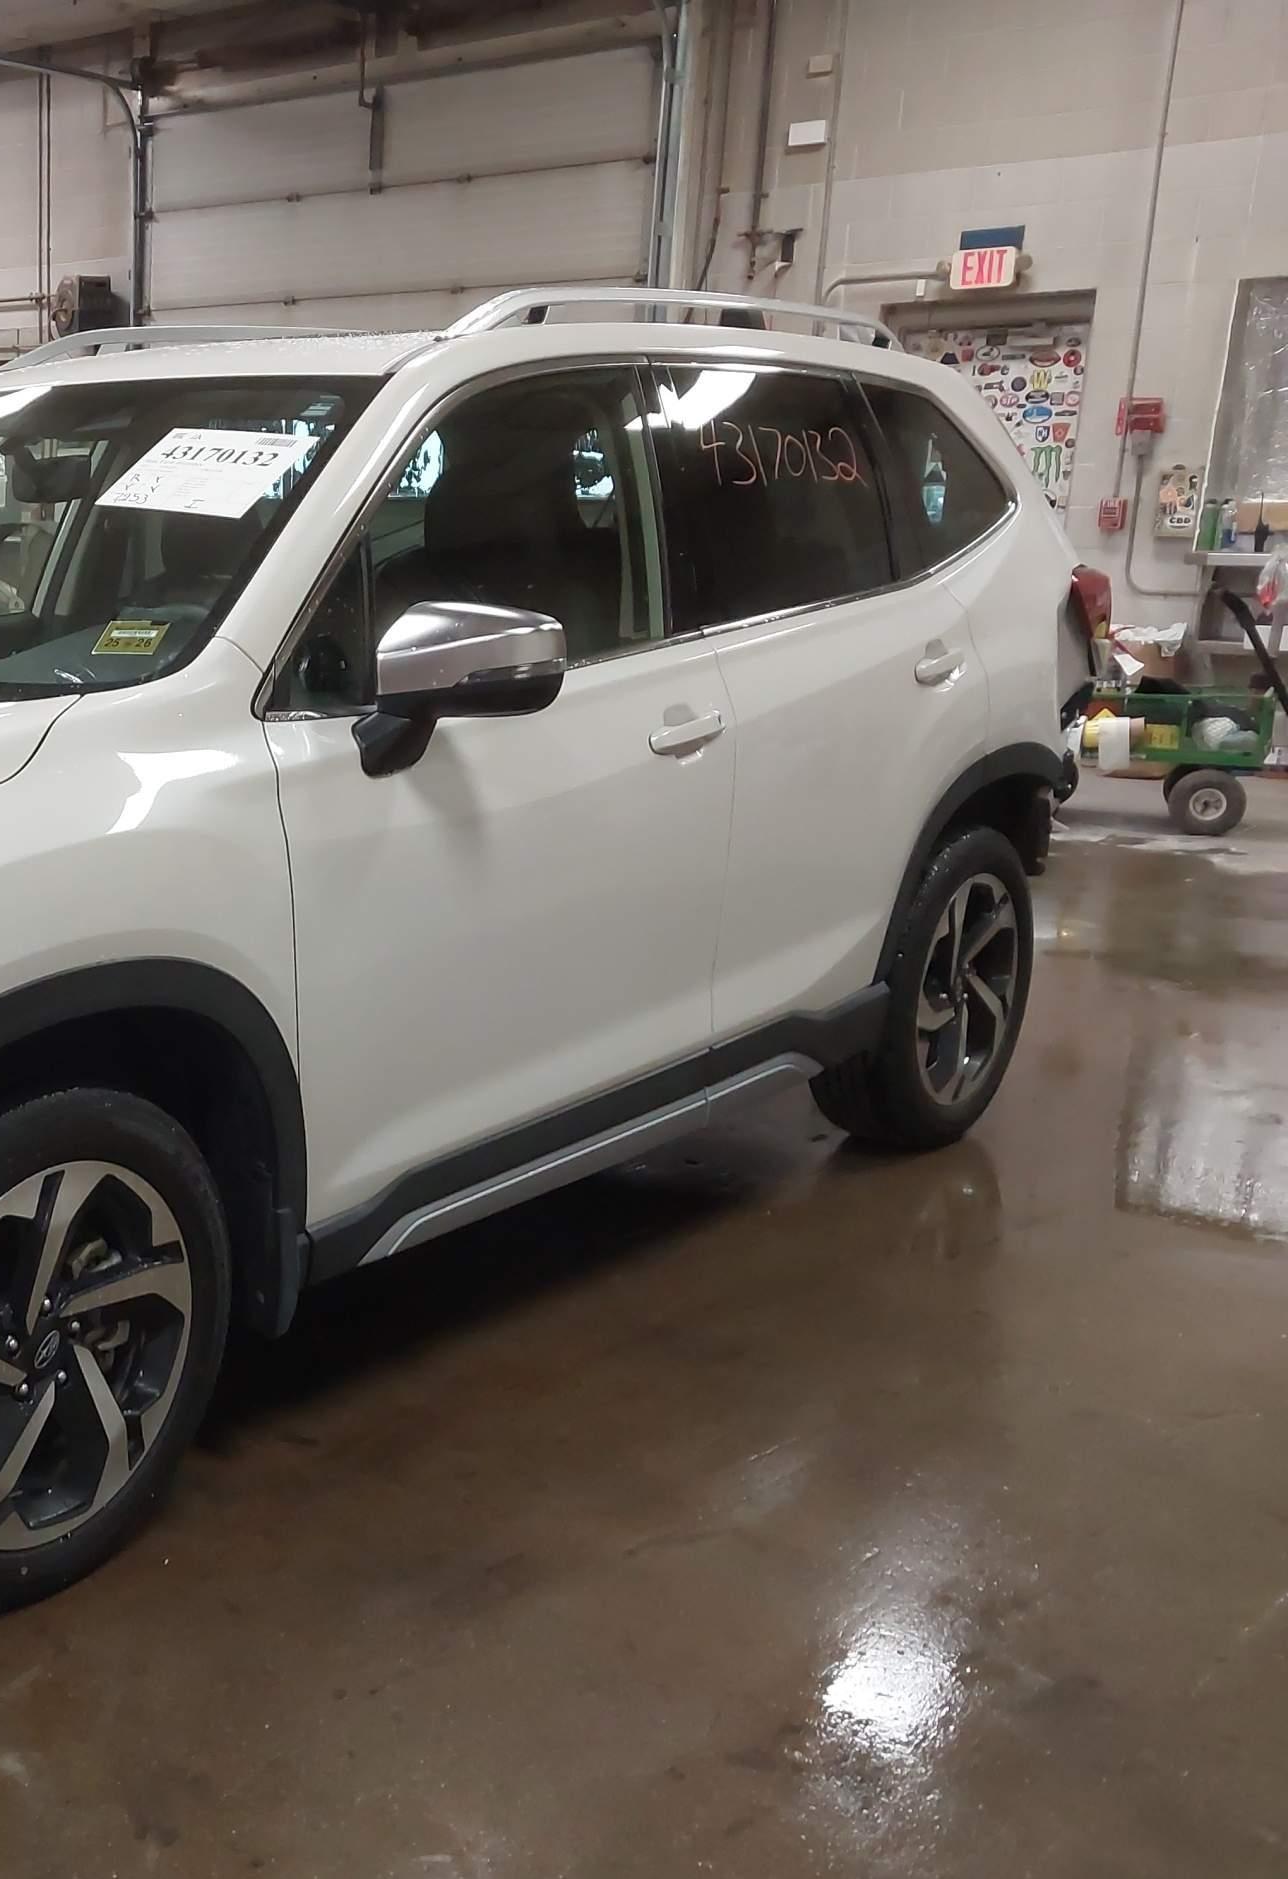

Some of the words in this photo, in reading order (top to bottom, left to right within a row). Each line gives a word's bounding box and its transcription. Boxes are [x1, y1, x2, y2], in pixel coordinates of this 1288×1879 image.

[961, 249, 1007, 286] EXIT
[160, 445, 280, 467] 43170132
[699, 419, 868, 487] 43170132
[1169, 516, 1191, 524] CBD
[104, 638, 120, 648] 25
